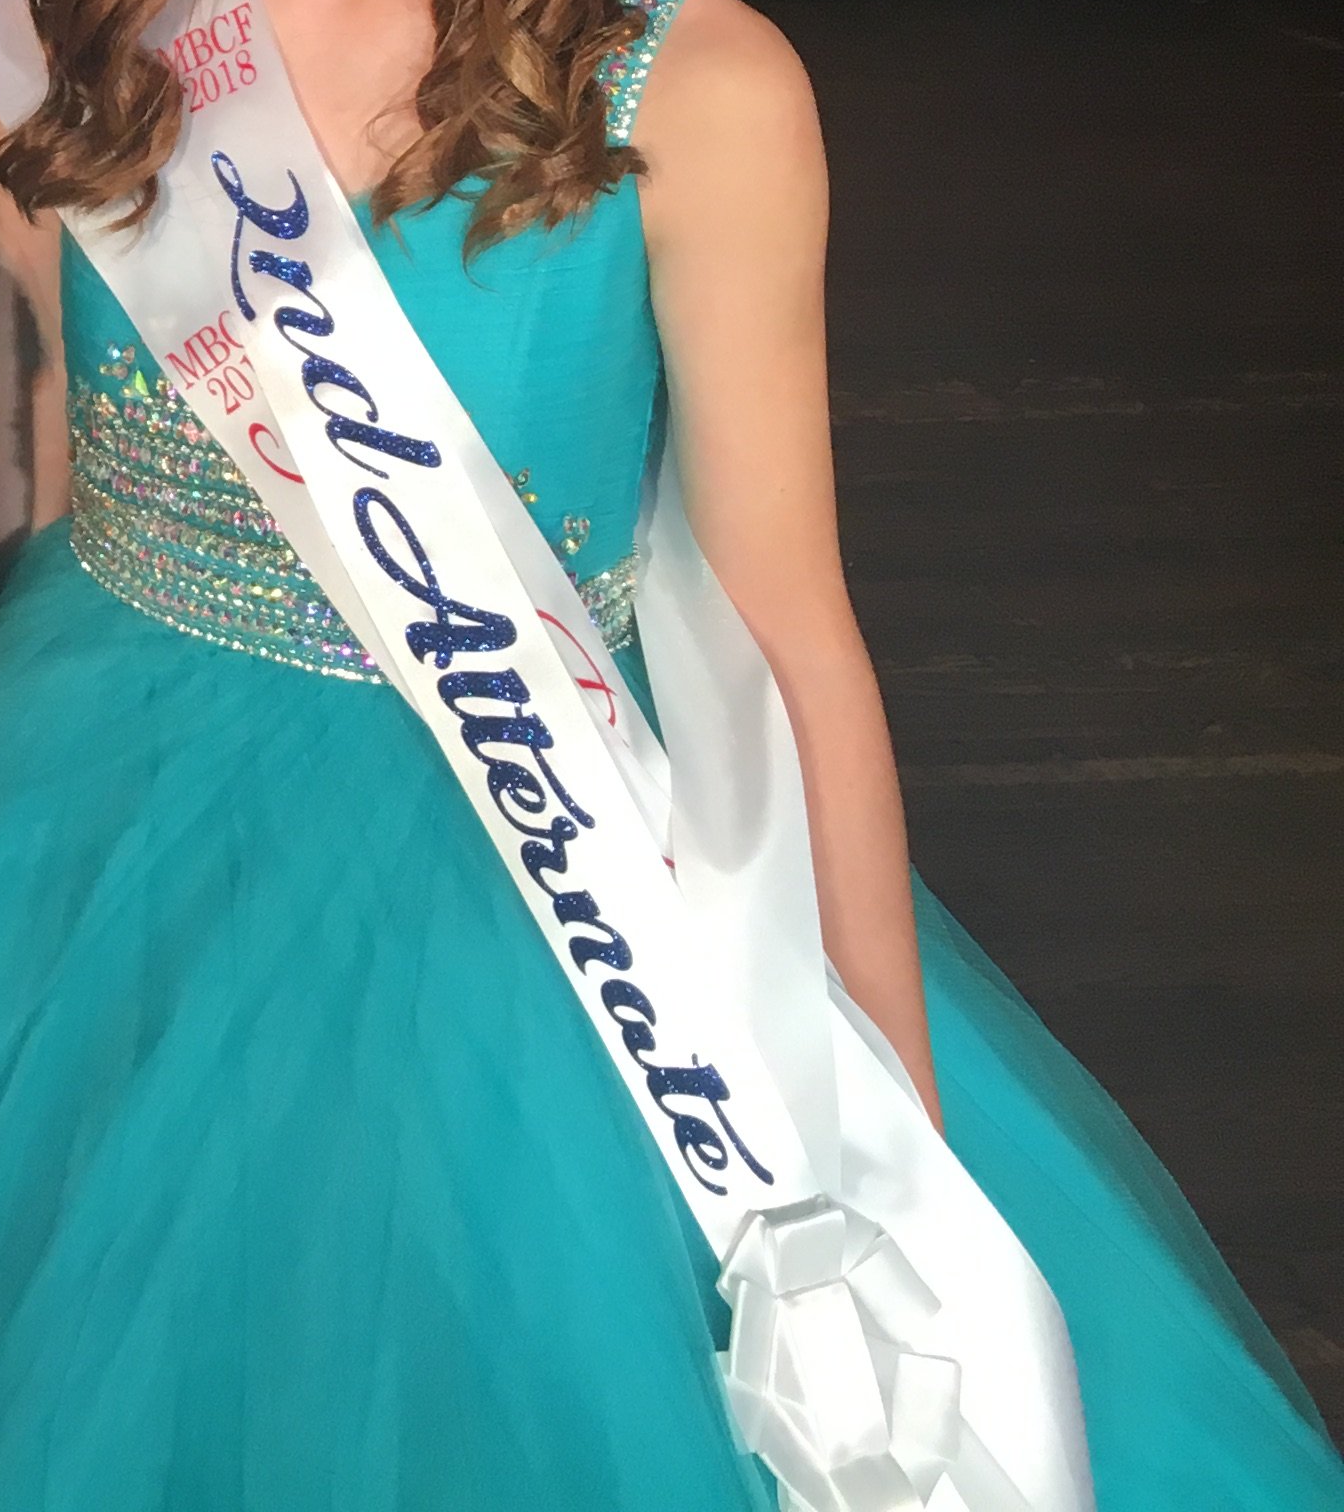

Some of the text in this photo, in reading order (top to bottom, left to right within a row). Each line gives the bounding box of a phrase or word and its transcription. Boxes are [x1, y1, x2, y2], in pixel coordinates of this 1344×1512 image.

[156, 2, 253, 76] MBCF
[182, 49, 257, 113] 2018
[165, 310, 244, 390] MBC
[206, 355, 256, 415] 20
[212, 149, 775, 1196] 2nd Alternate
